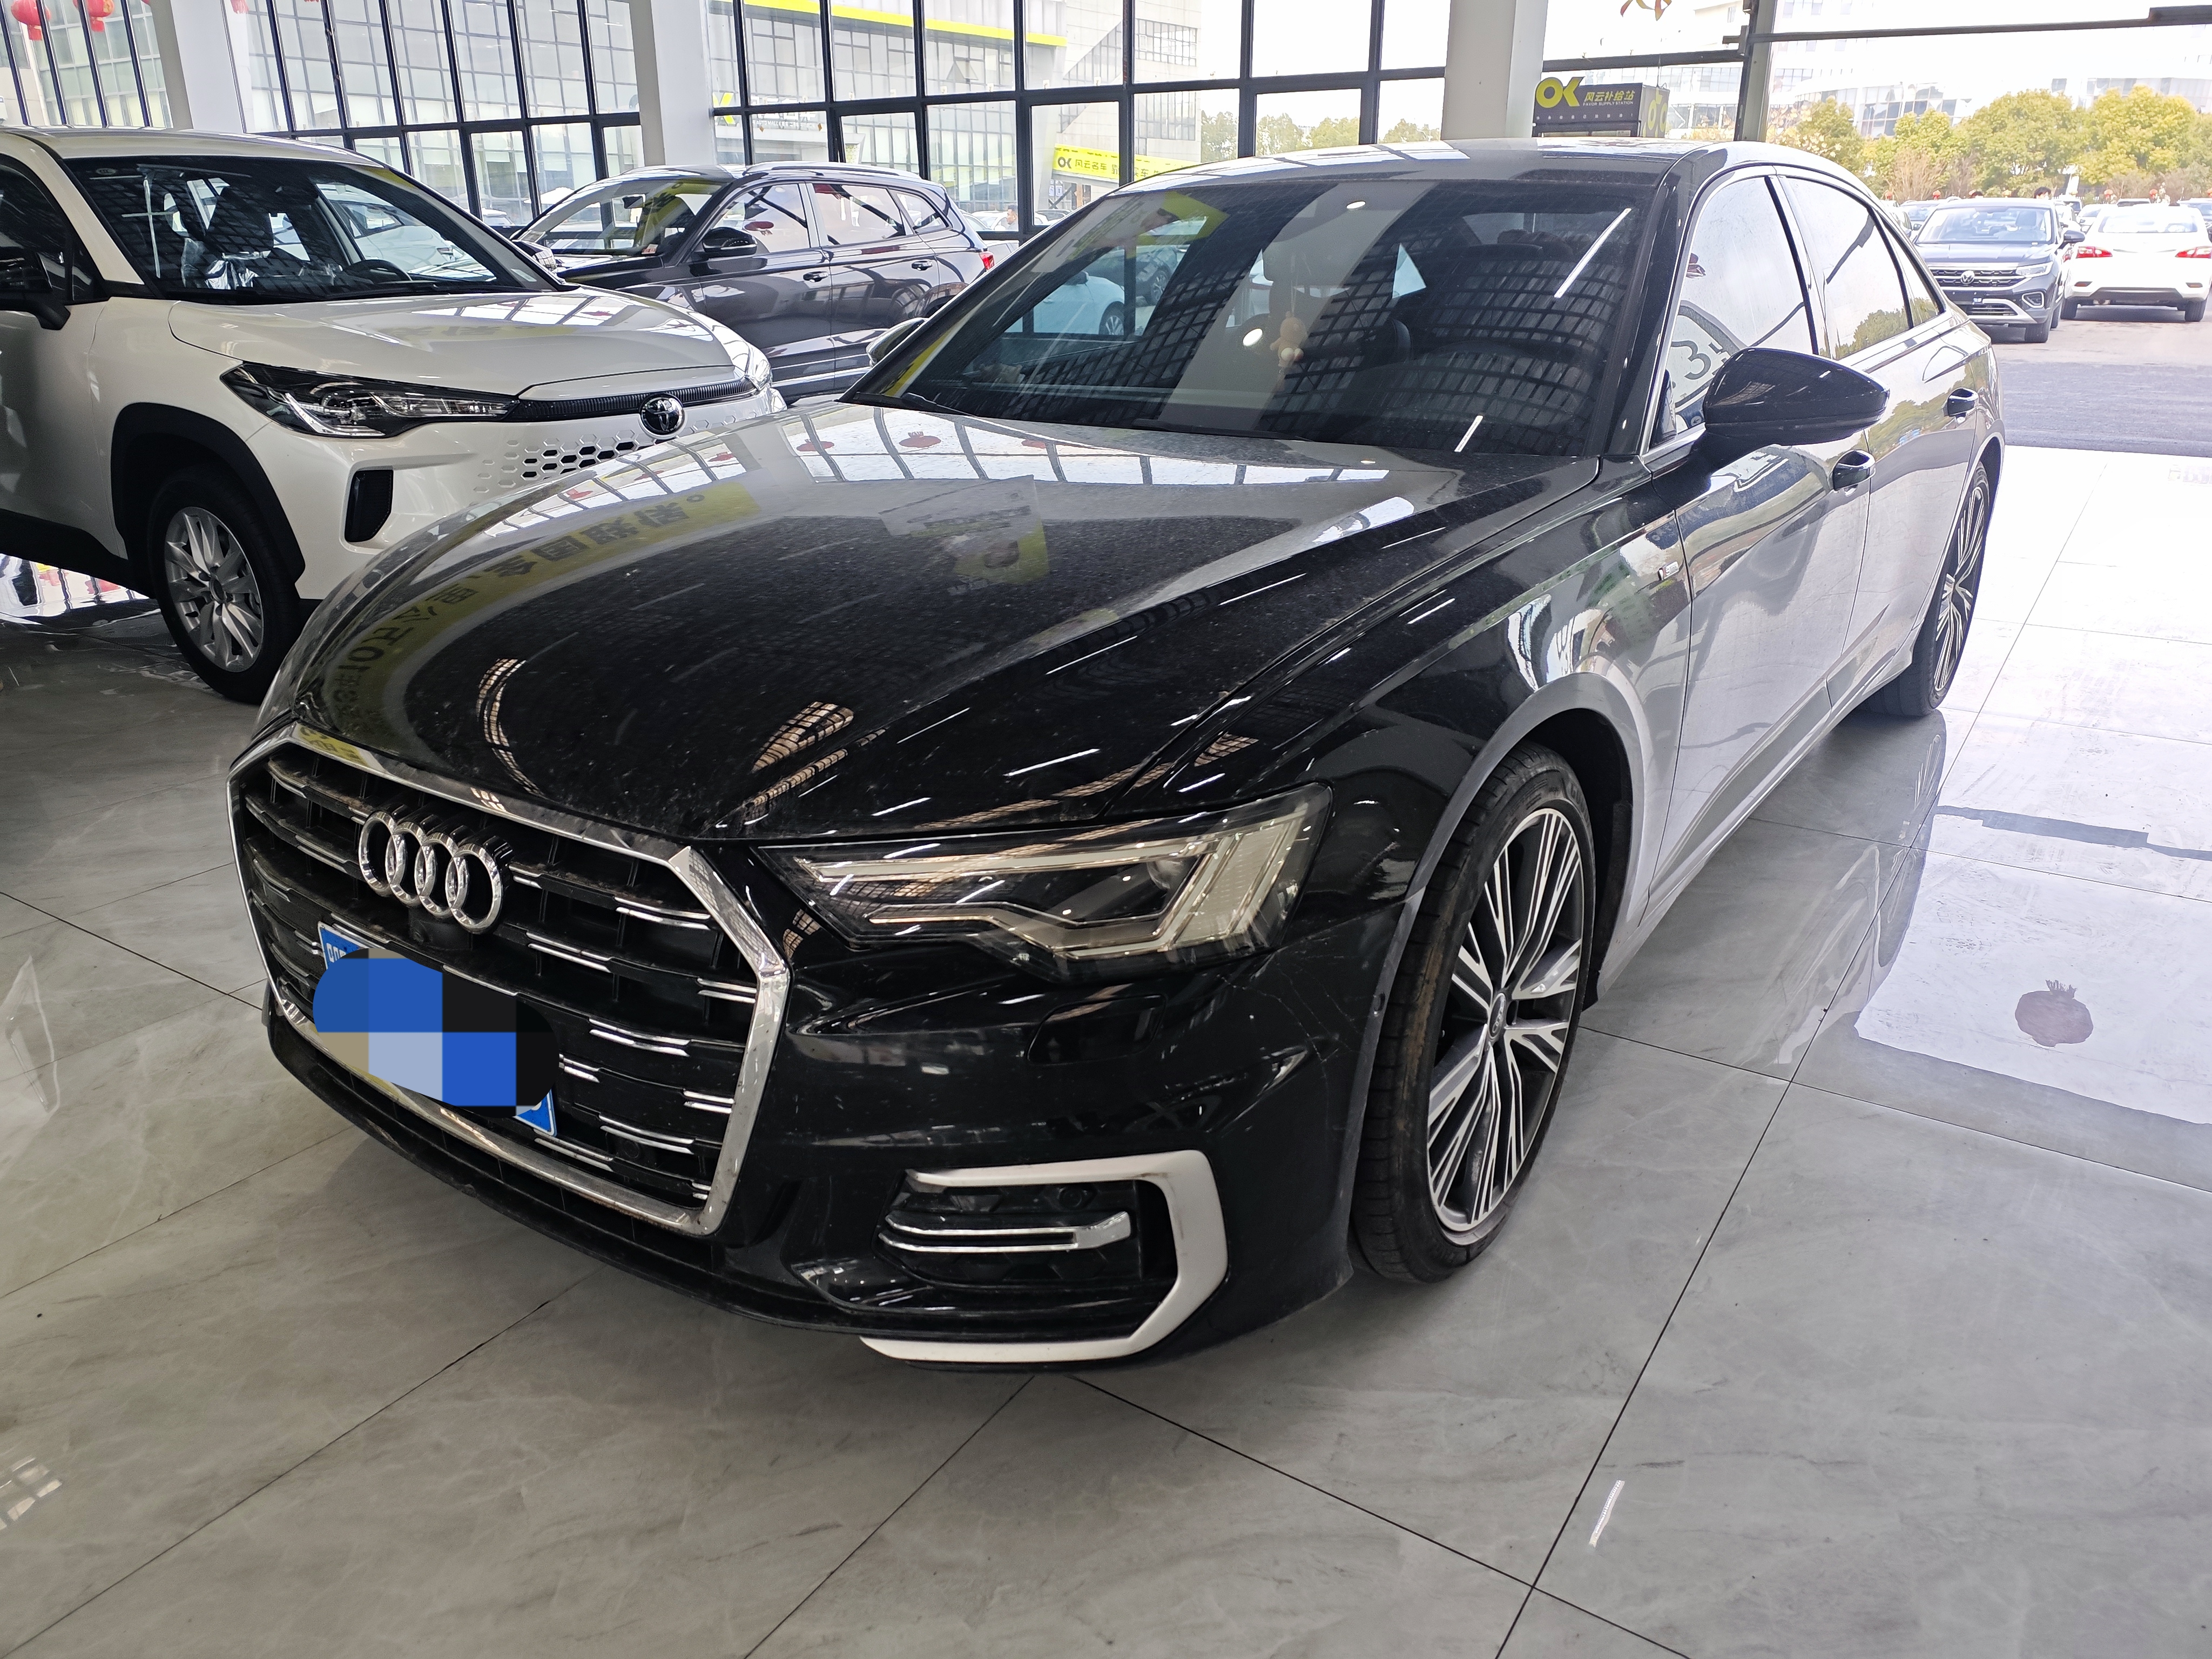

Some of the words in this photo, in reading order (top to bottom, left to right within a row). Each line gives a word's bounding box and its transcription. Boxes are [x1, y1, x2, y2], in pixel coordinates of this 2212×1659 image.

[1536, 77, 1585, 108] OK
[1584, 90, 1635, 102] 风云补给站
[1075, 159, 1107, 170] 风云名车
